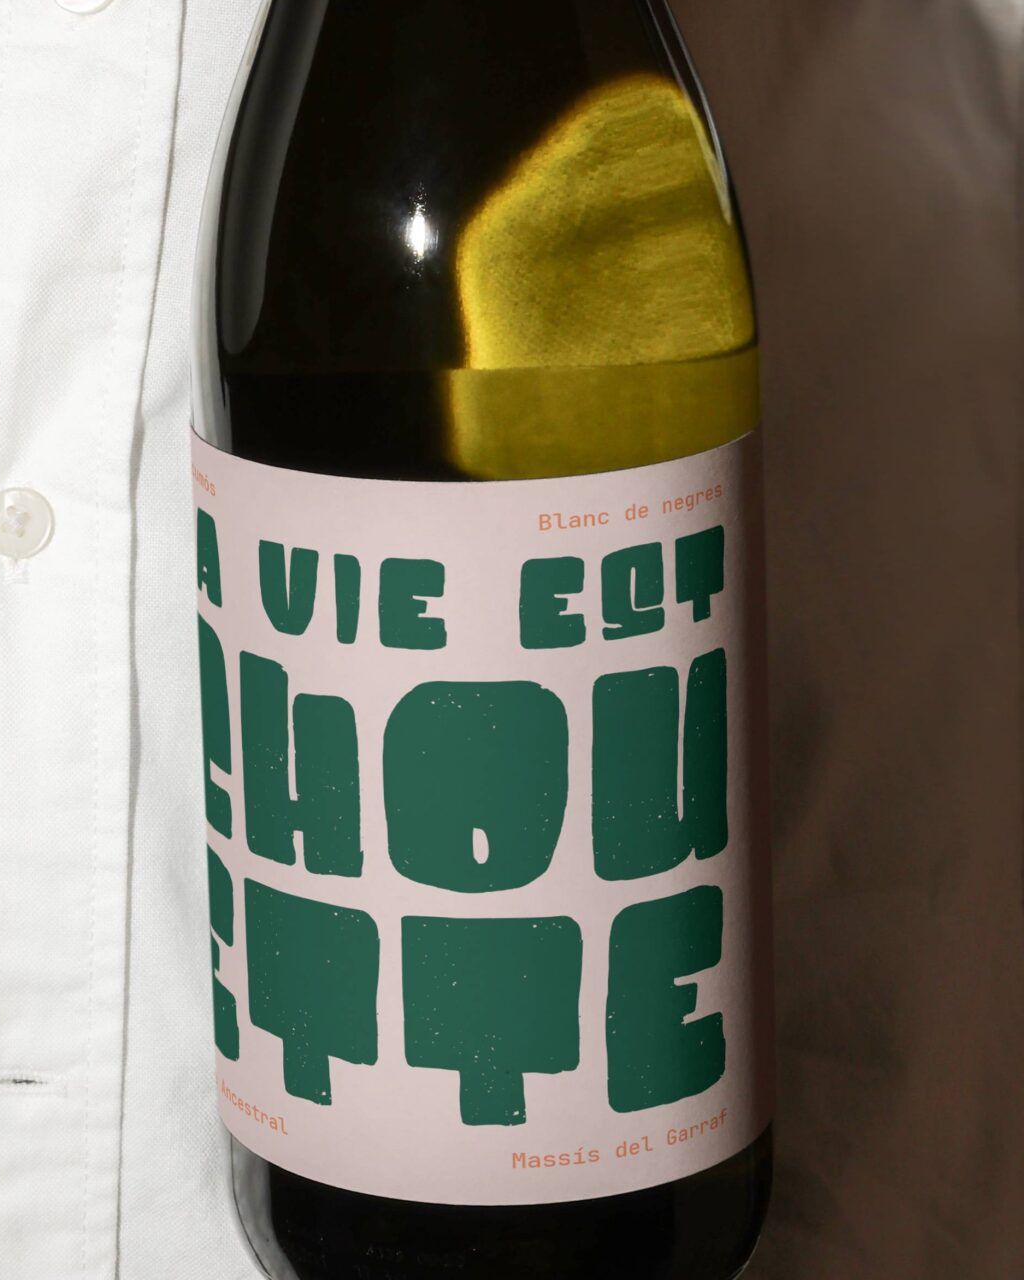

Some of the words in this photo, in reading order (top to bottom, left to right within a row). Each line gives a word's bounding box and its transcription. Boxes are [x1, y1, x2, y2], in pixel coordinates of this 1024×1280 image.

[538, 511, 610, 532] Blanc
[624, 502, 649, 522] de
[661, 482, 724, 515] negres
[259, 539, 447, 650] VIE
[519, 524, 724, 650] EST
[220, 1078, 288, 1136] Ancestral
[511, 1147, 600, 1169] Massís
[614, 1136, 653, 1158] del
[665, 1108, 729, 1146] Garraf
